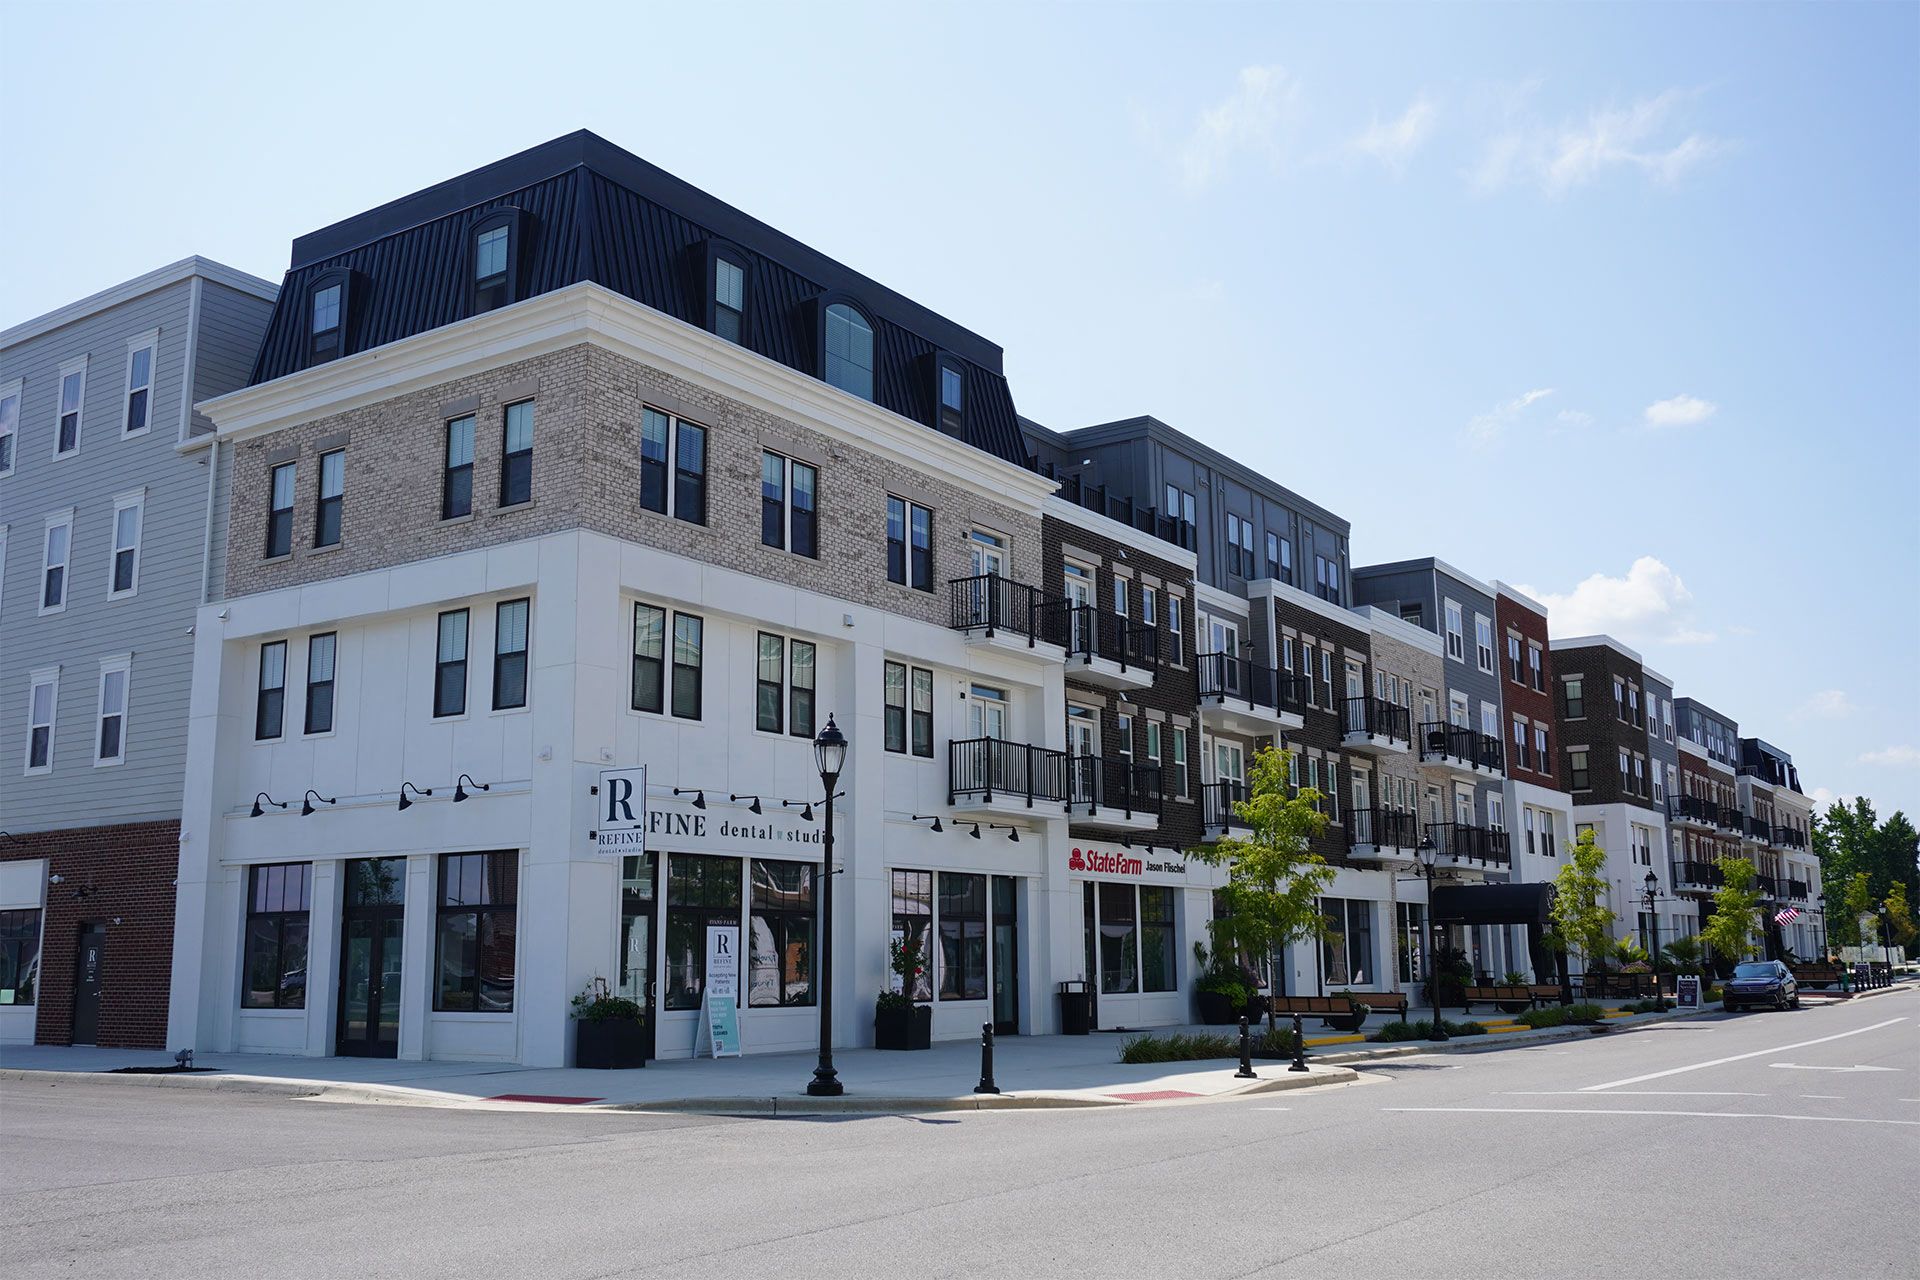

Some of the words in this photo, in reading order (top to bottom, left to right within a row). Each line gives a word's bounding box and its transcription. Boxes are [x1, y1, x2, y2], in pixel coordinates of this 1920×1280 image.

[606, 778, 637, 822] R
[598, 832, 642, 845] REFINE
[720, 820, 773, 840] dental
[1145, 861, 1163, 872] Jason
[717, 934, 729, 954] R
